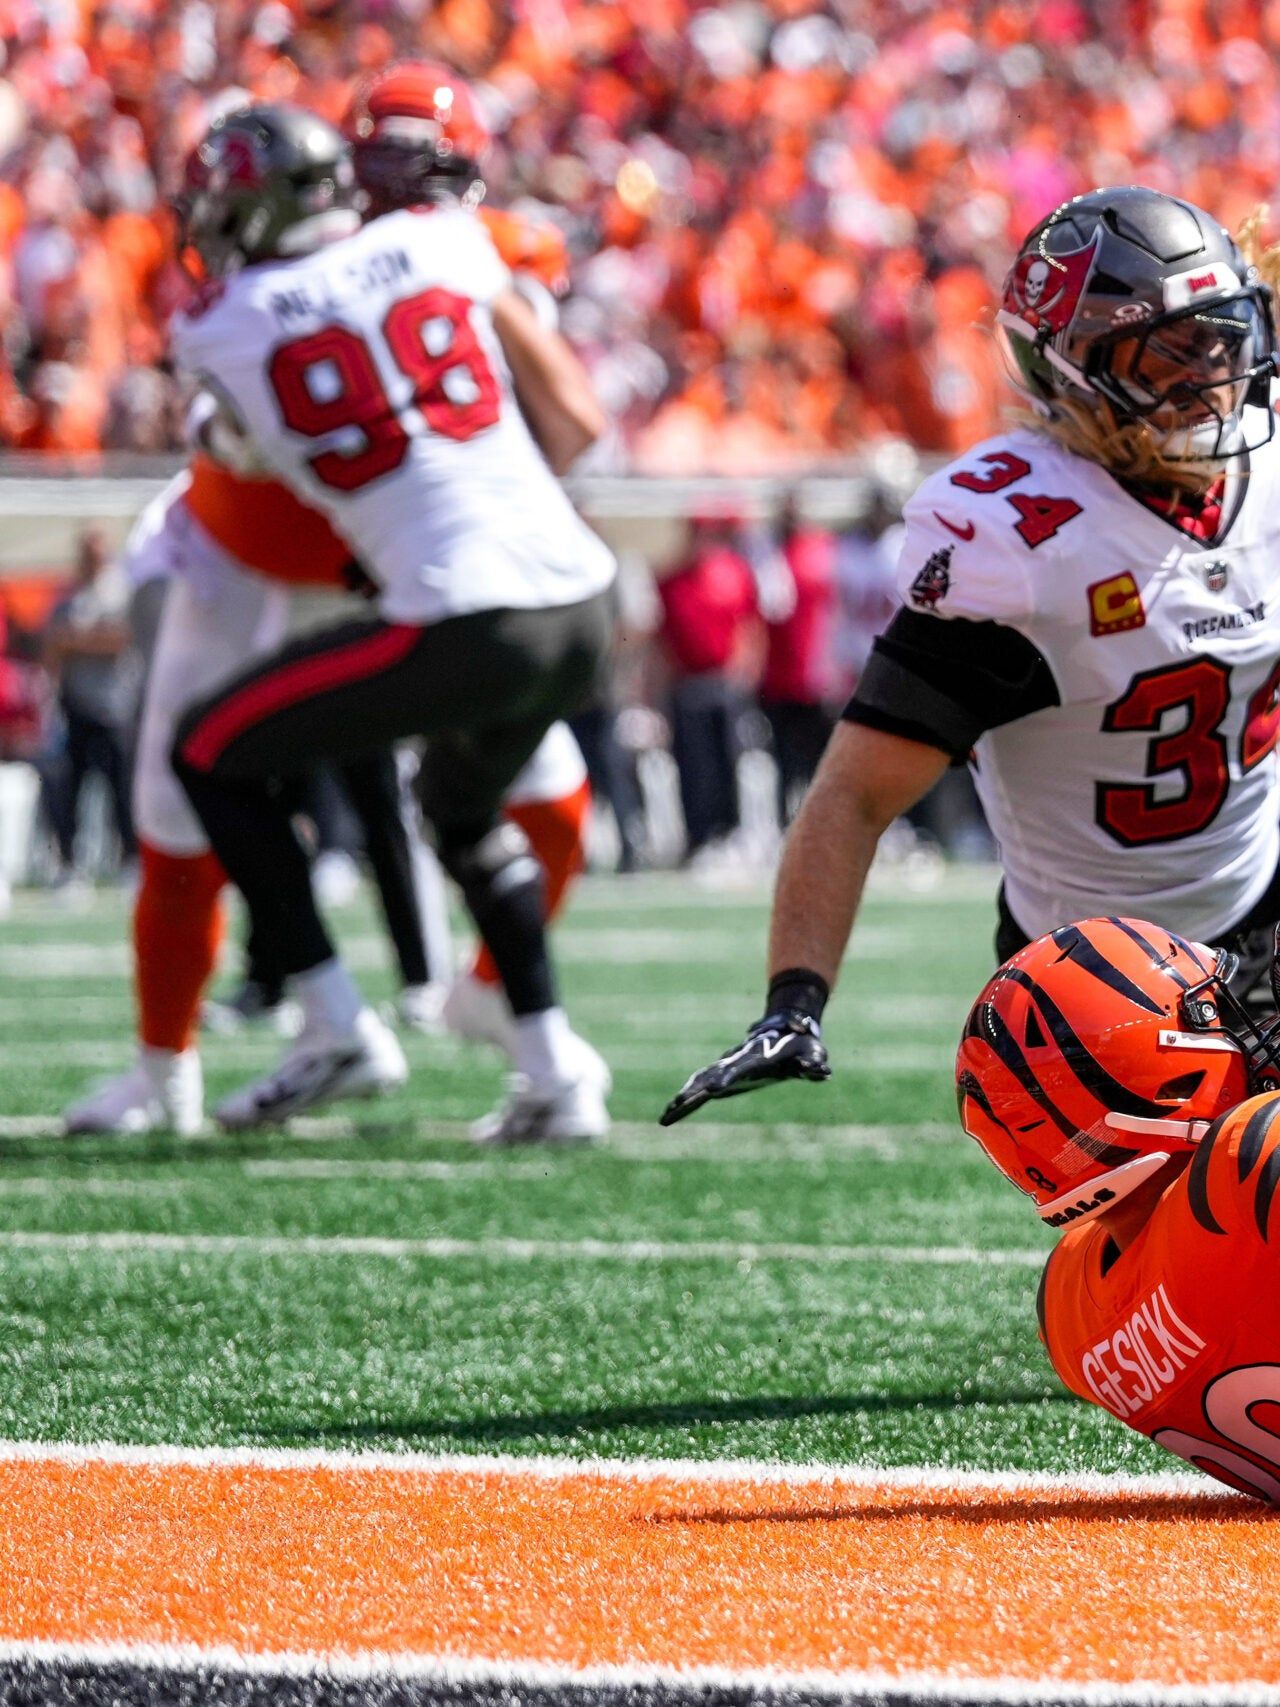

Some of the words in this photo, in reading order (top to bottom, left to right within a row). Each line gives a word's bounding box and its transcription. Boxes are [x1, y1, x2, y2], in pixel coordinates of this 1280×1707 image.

[266, 284, 502, 493] 98
[950, 450, 1083, 549] 34
[1093, 574, 1141, 614] C
[1025, 1166, 1057, 1194] 8
[1081, 1283, 1207, 1420] GESICKI
